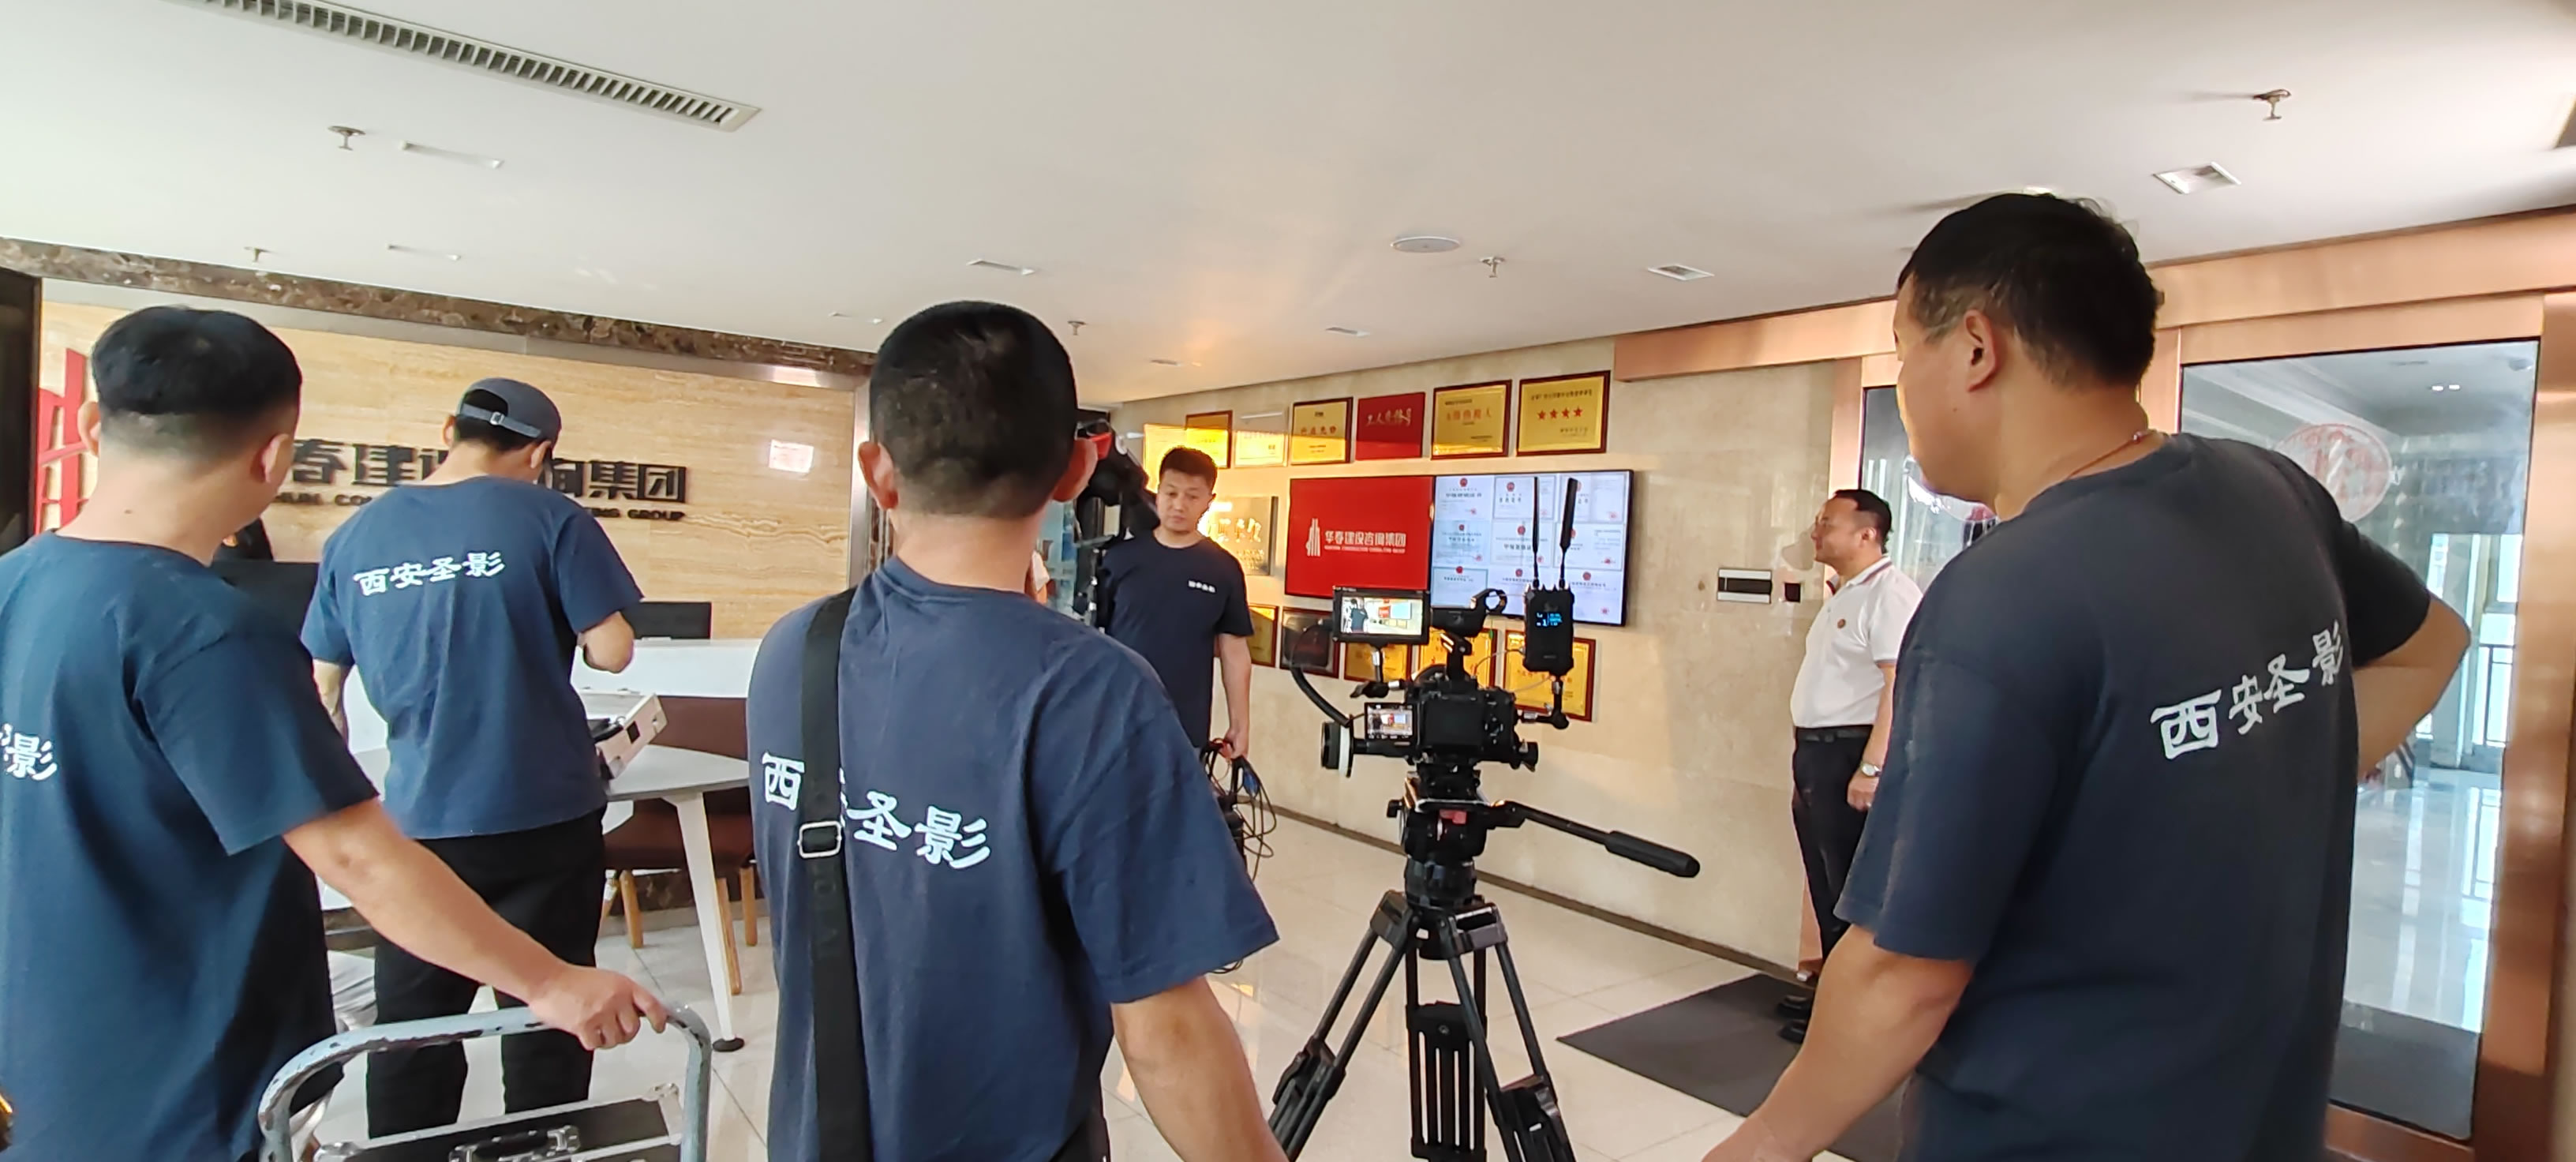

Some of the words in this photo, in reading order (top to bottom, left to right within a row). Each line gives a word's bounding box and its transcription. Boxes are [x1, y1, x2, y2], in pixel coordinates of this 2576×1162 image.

[353, 552, 505, 596] 西安圣影
[2150, 621, 2345, 760] 西安圣影
[761, 752, 991, 869] 西圣影
